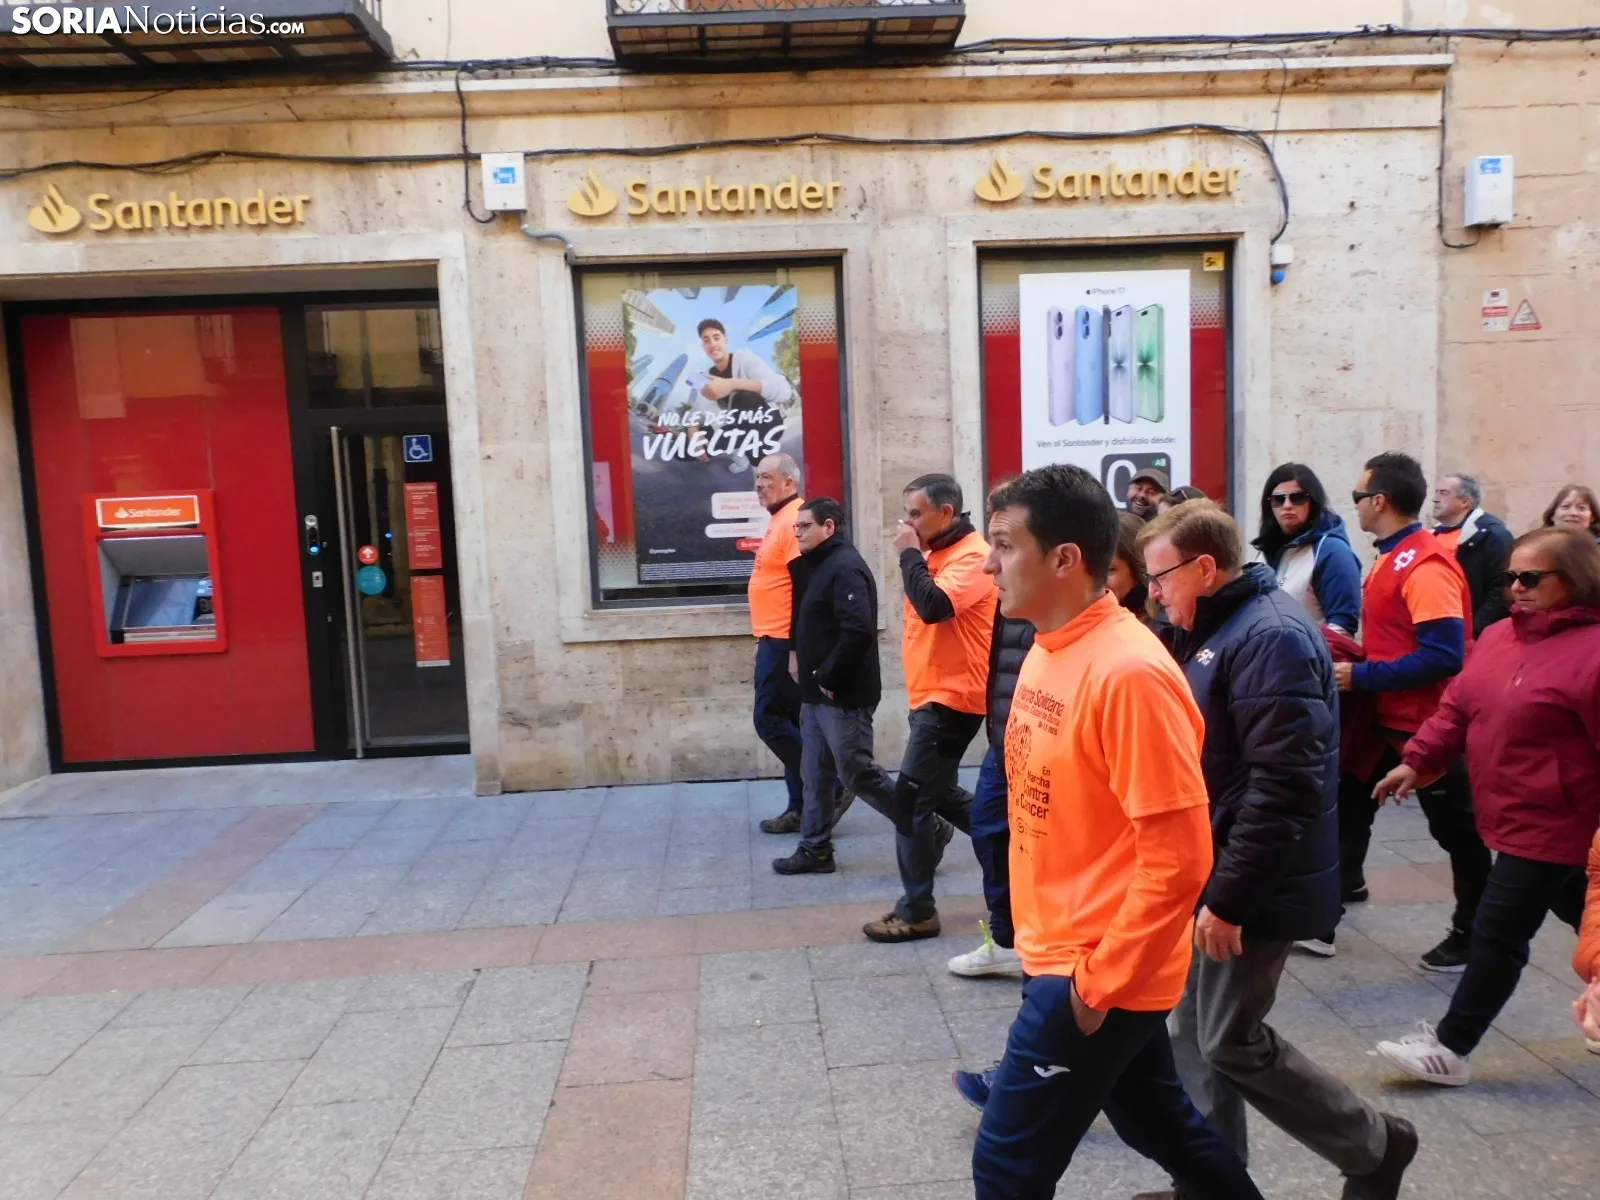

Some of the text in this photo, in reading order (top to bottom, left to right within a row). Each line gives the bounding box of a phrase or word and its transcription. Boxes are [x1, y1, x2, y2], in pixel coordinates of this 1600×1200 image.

[1032, 161, 1240, 198] Santander
[626, 174, 841, 215] Santander
[87, 190, 310, 232] Santander
[657, 406, 777, 427] NO LE DES MÁS
[642, 424, 788, 461] VUELTAS
[1036, 440, 1052, 448] Ven
[1062, 438, 1103, 447] Santander
[128, 508, 182, 517] Santander
[1027, 769, 1050, 789] Marcha
[1042, 766, 1050, 776] En
[1023, 779, 1050, 804] Contra
